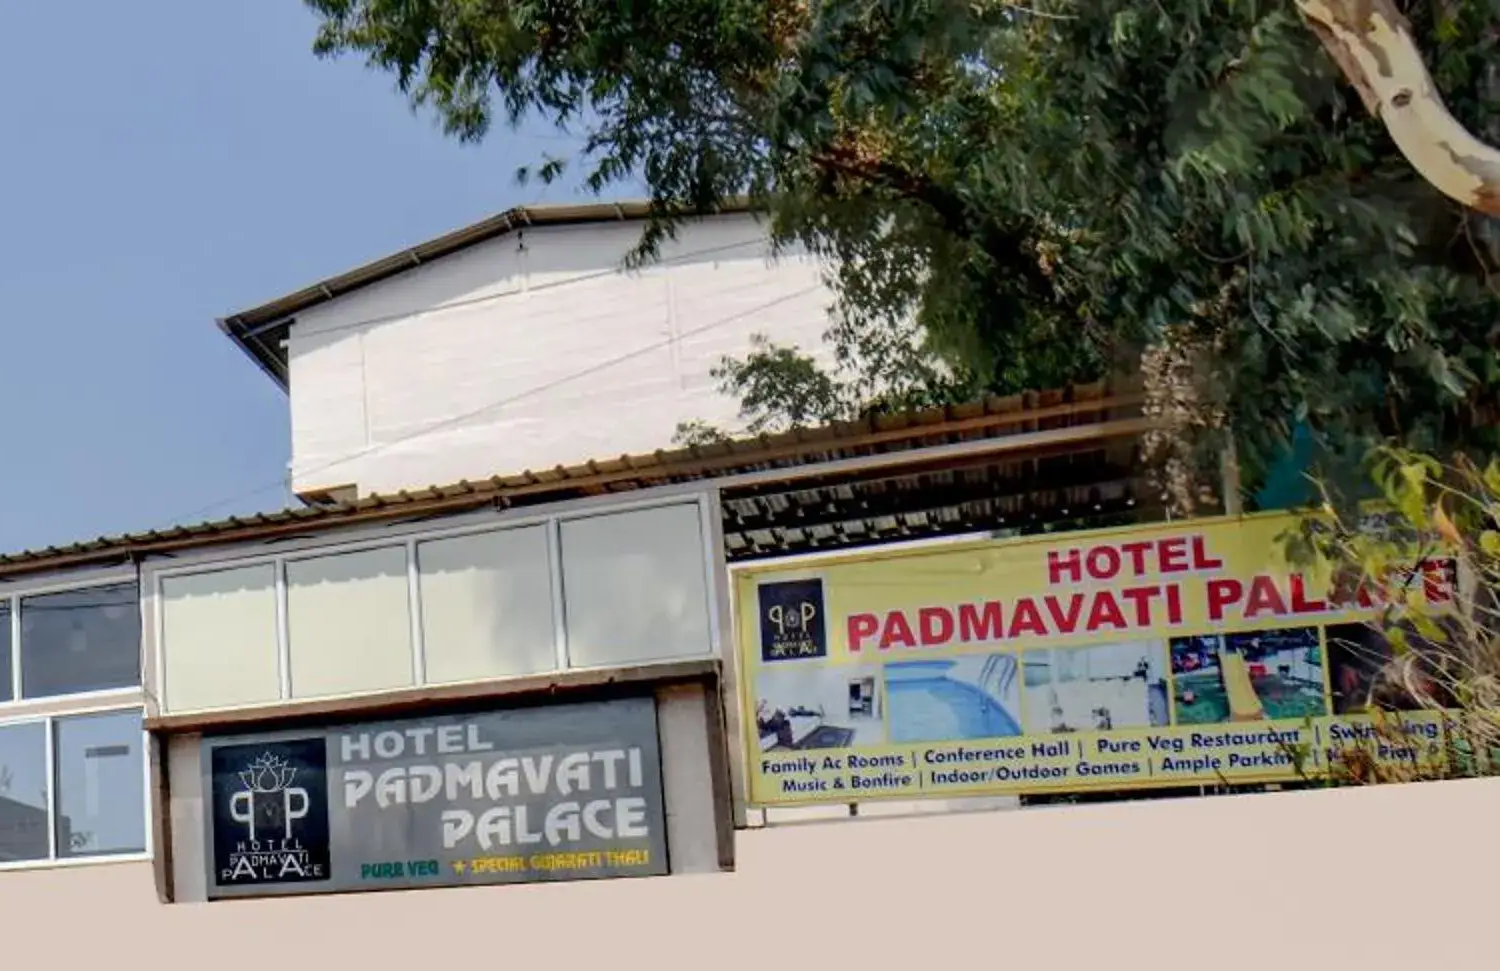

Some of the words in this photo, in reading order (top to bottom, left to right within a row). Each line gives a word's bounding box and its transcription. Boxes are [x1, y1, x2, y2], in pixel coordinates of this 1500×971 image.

[1047, 535, 1222, 585] HOTEL
[846, 585, 1182, 654] PADMAVATI
[341, 724, 494, 762] HOTEL
[762, 757, 816, 775] Family
[822, 753, 843, 771] Ac
[847, 751, 904, 770] Rooms
[924, 746, 1025, 764] Conference
[1032, 740, 1070, 758] Hall
[1097, 737, 1141, 754] Pure
[1147, 734, 1184, 753] Veg
[1191, 728, 1299, 748] Restaurant
[342, 747, 643, 808] PADMAVATI
[783, 775, 827, 793] Music
[833, 774, 845, 789] &
[851, 770, 911, 790] Bonfire
[931, 764, 1069, 785] Indoor/Outdoor
[1076, 759, 1140, 776] Games
[1161, 755, 1222, 773] Ample
[1229, 750, 1297, 769] Parkin
[237, 838, 303, 852] HOTEL
[441, 797, 649, 851] PALACE
[361, 861, 405, 879] PURE
[407, 859, 440, 877] VEG
[470, 856, 525, 875] SPECIAL
[530, 852, 601, 872] GUJARATI
[605, 849, 649, 867] THALI
